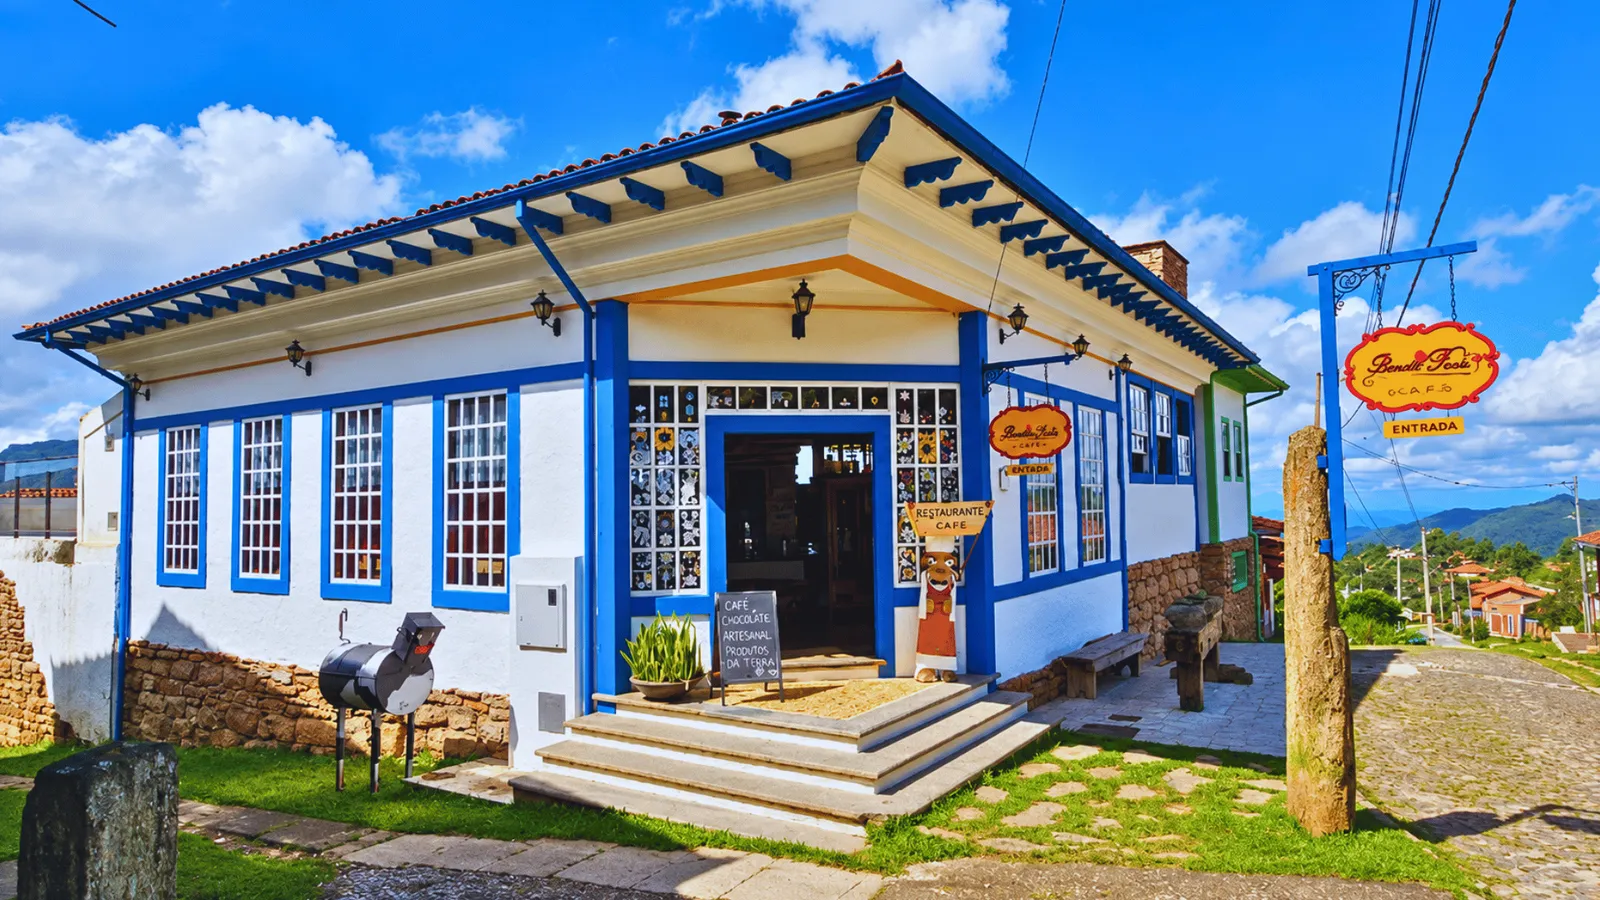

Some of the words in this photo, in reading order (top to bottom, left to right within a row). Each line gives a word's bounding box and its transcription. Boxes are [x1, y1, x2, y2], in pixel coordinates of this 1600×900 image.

[1392, 421, 1458, 434] ENTRADA
[916, 506, 984, 518] RESTAURANTE
[936, 521, 967, 529] CAFE
[725, 597, 749, 611] CAFÉ
[723, 630, 772, 641] ARTESANAL
[726, 645, 770, 657] PRODUTOS
[727, 659, 740, 669] DA
[743, 658, 775, 669] TERRA
